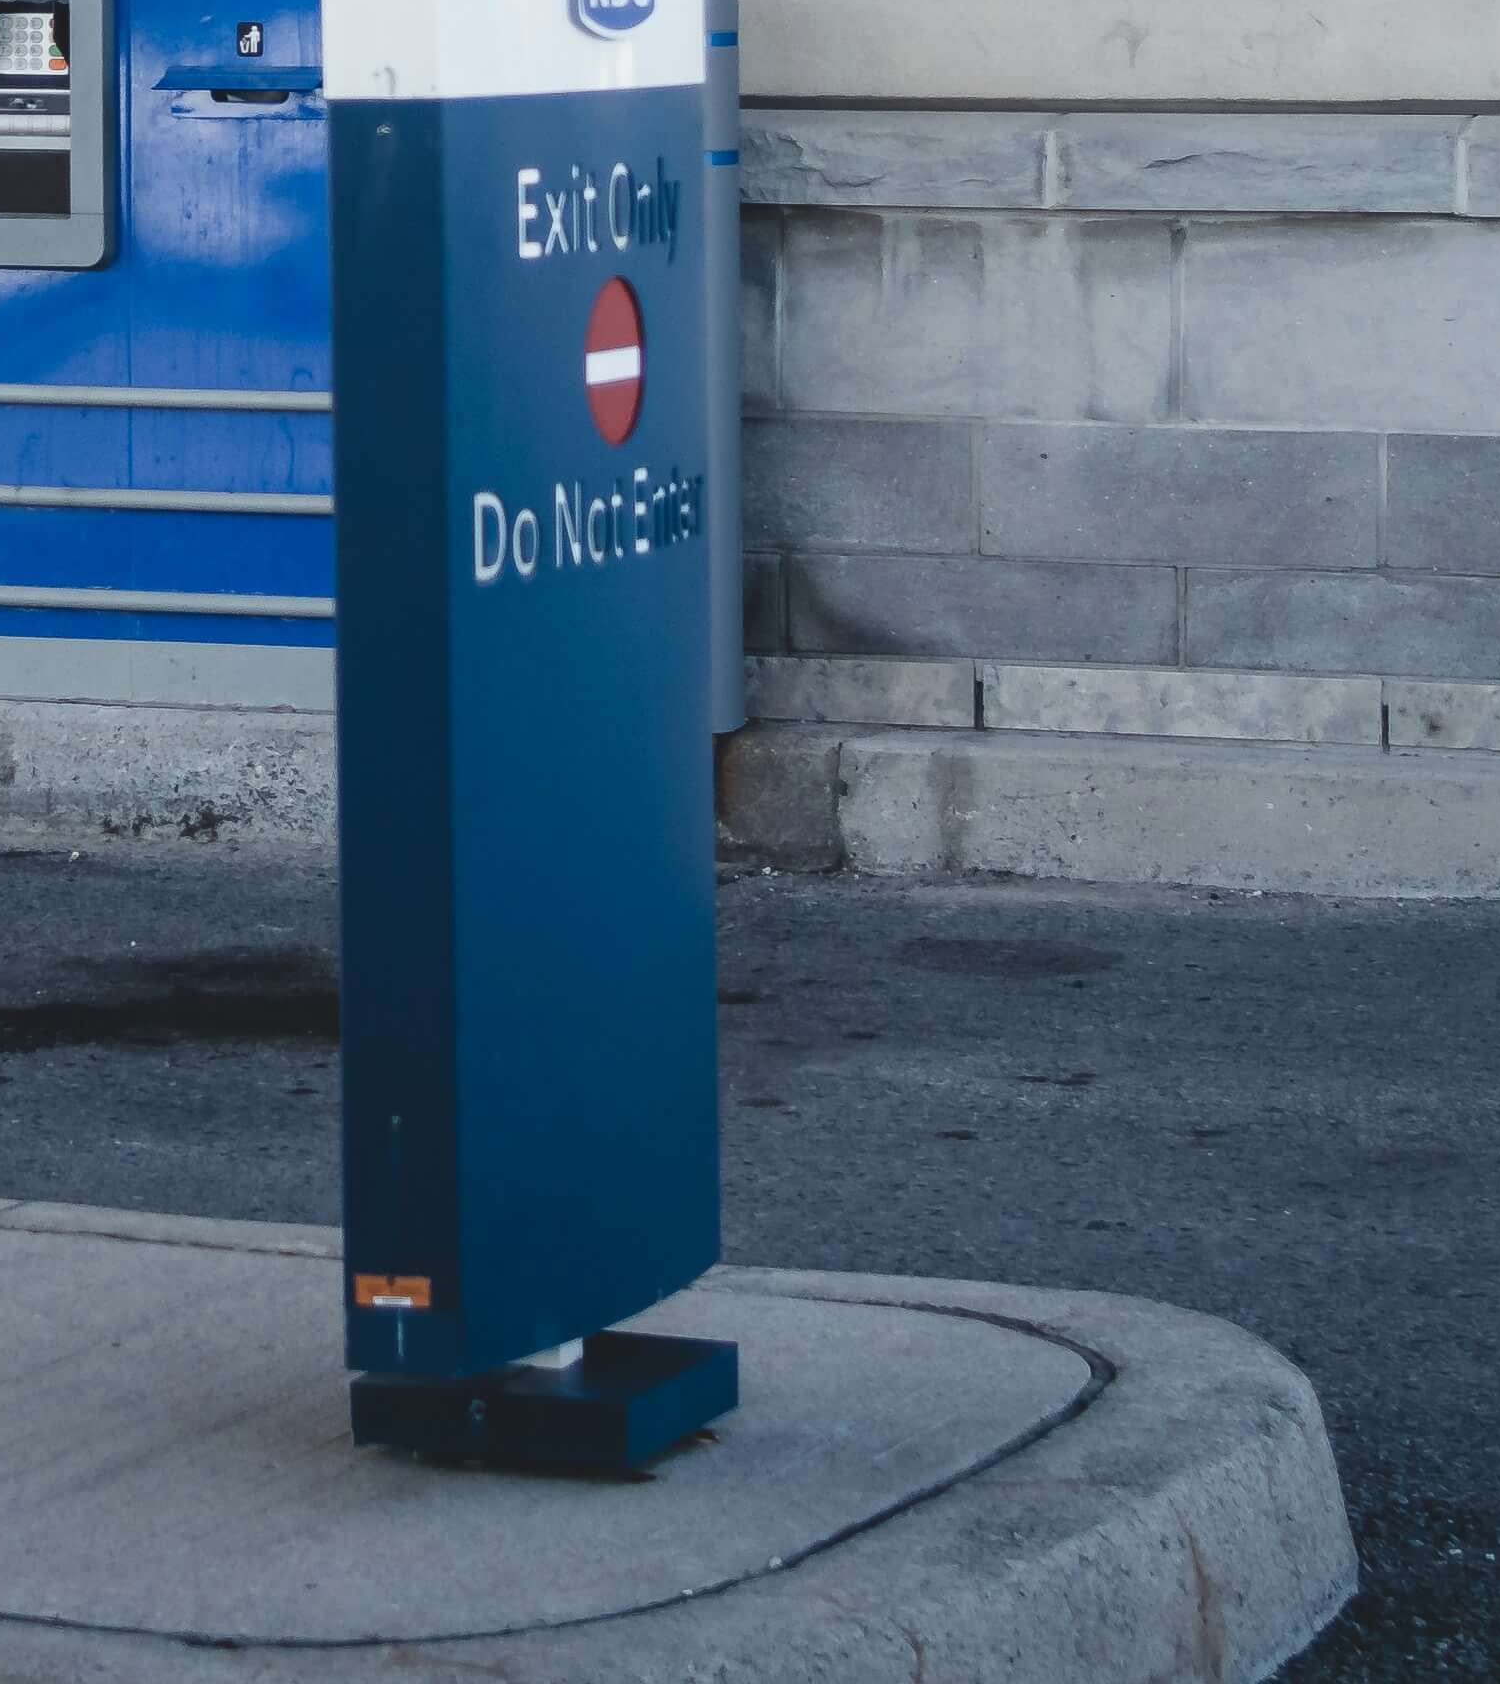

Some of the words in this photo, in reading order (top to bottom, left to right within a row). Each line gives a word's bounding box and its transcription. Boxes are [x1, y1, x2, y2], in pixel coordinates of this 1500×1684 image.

[517, 164, 600, 260] Exit
[608, 156, 682, 264] Only
[473, 490, 539, 583] Do
[555, 478, 625, 568] Not
[633, 466, 704, 556] Enter
